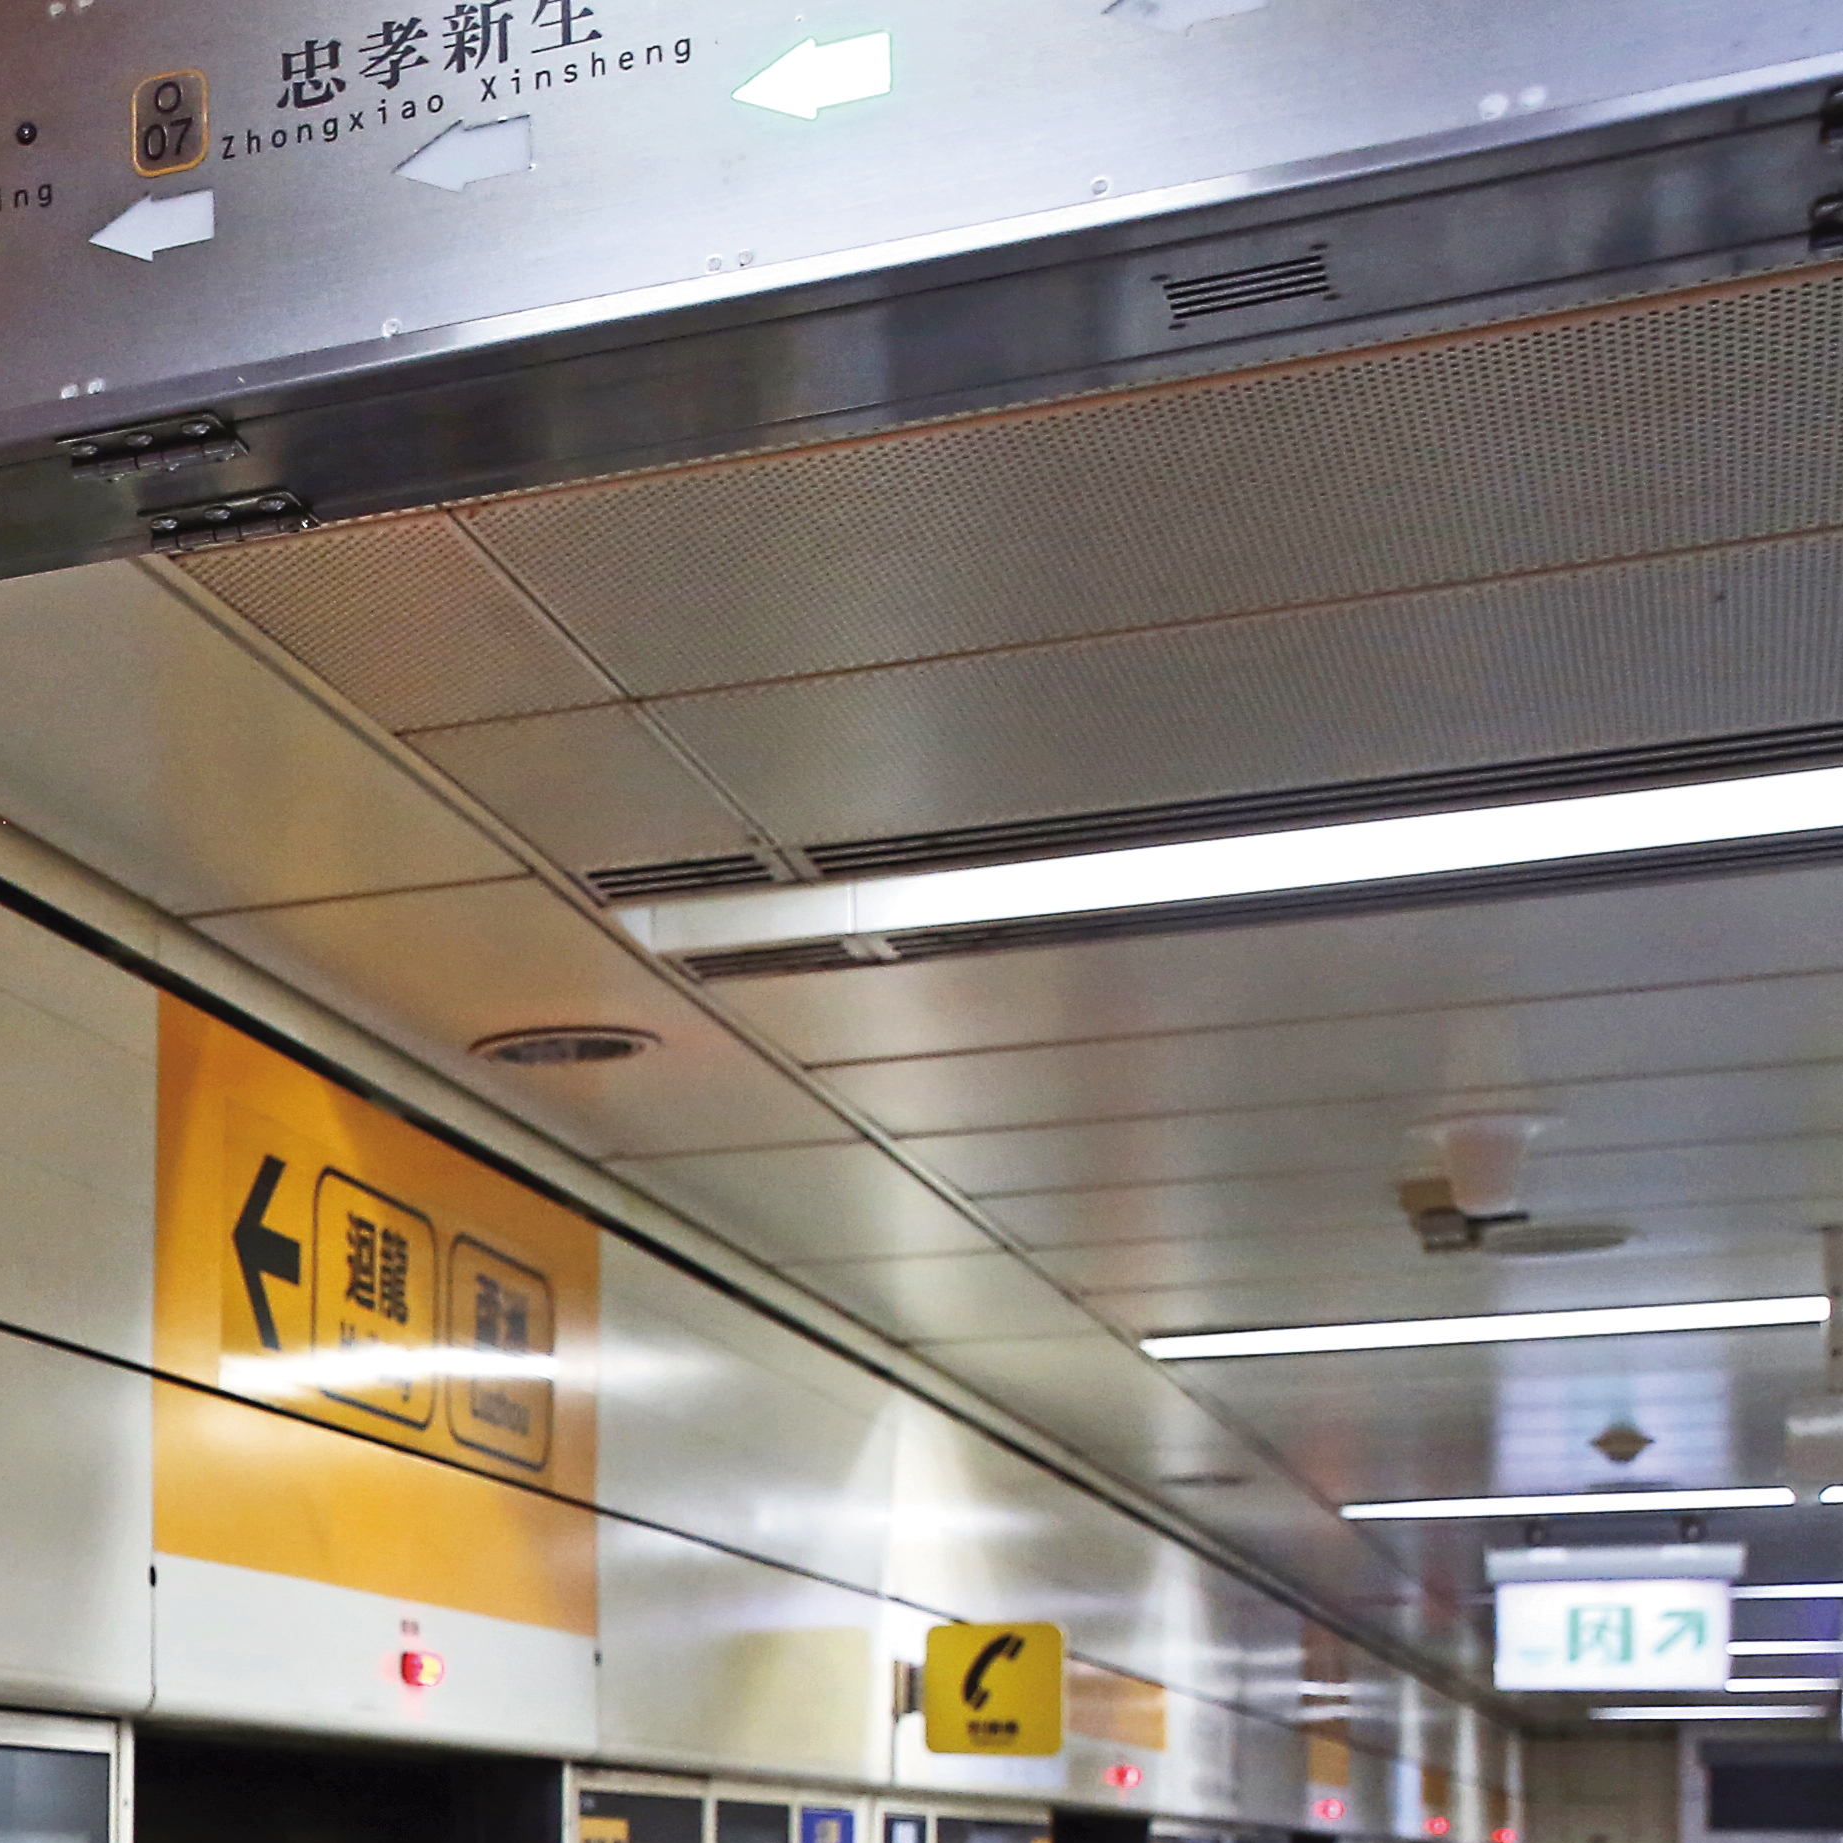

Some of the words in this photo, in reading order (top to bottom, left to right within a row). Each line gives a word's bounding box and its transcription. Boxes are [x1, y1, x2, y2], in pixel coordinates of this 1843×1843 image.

[221, 92, 444, 160] Zhongxiao
[480, 38, 694, 101] Xinsheng
[277, 0, 602, 108] 忠孝新生
[144, 117, 194, 161] 07
